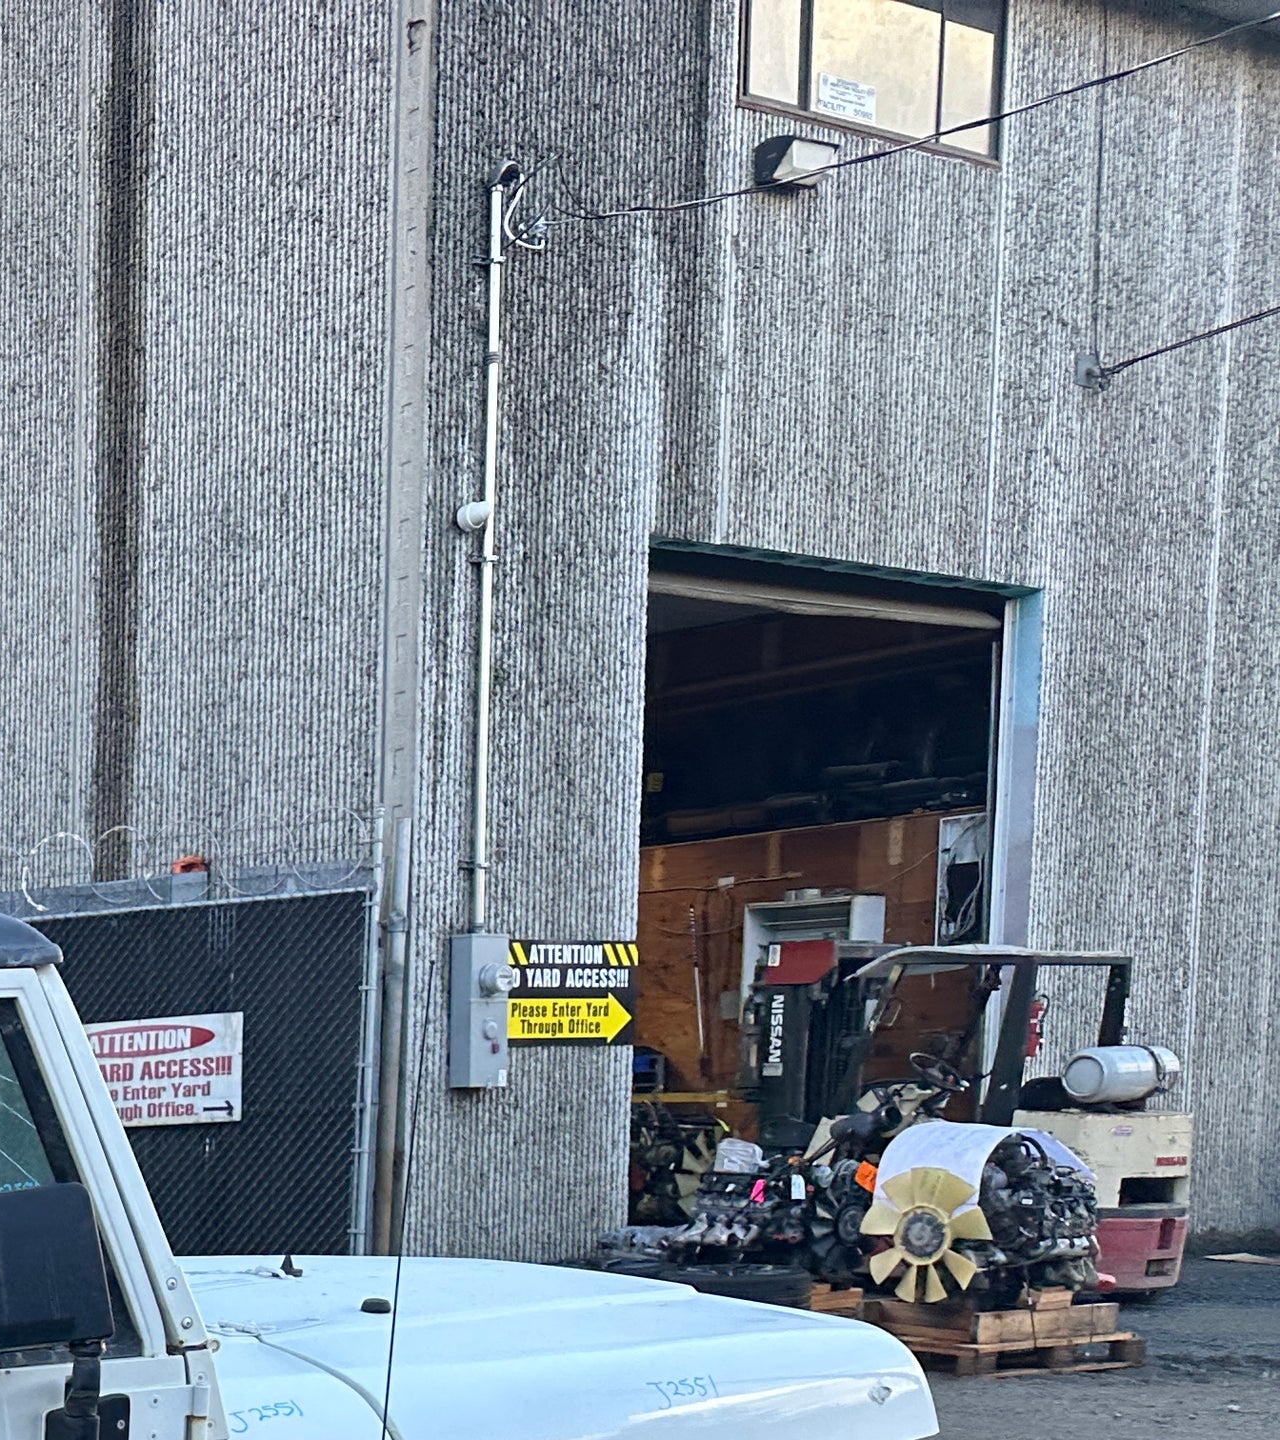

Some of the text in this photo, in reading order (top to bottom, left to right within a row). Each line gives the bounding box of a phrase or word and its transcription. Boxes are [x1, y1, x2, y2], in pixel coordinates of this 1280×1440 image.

[529, 944, 603, 965] ATTENTION
[526, 968, 561, 988] YARD
[565, 968, 629, 988] ACCESS!!!
[511, 1001, 609, 1018] Please Enter Yard
[520, 1018, 601, 1037] Through Office
[768, 994, 785, 1063] NISSAN
[89, 1028, 191, 1055] ATTENTION
[99, 1056, 233, 1083] ARD ACCESS!!!
[123, 1085, 166, 1102] Enter
[171, 1081, 211, 1099] Yard
[147, 1101, 198, 1119] Office.
[645, 1374, 719, 1411] J2551
[228, 1400, 304, 1433] J2551
